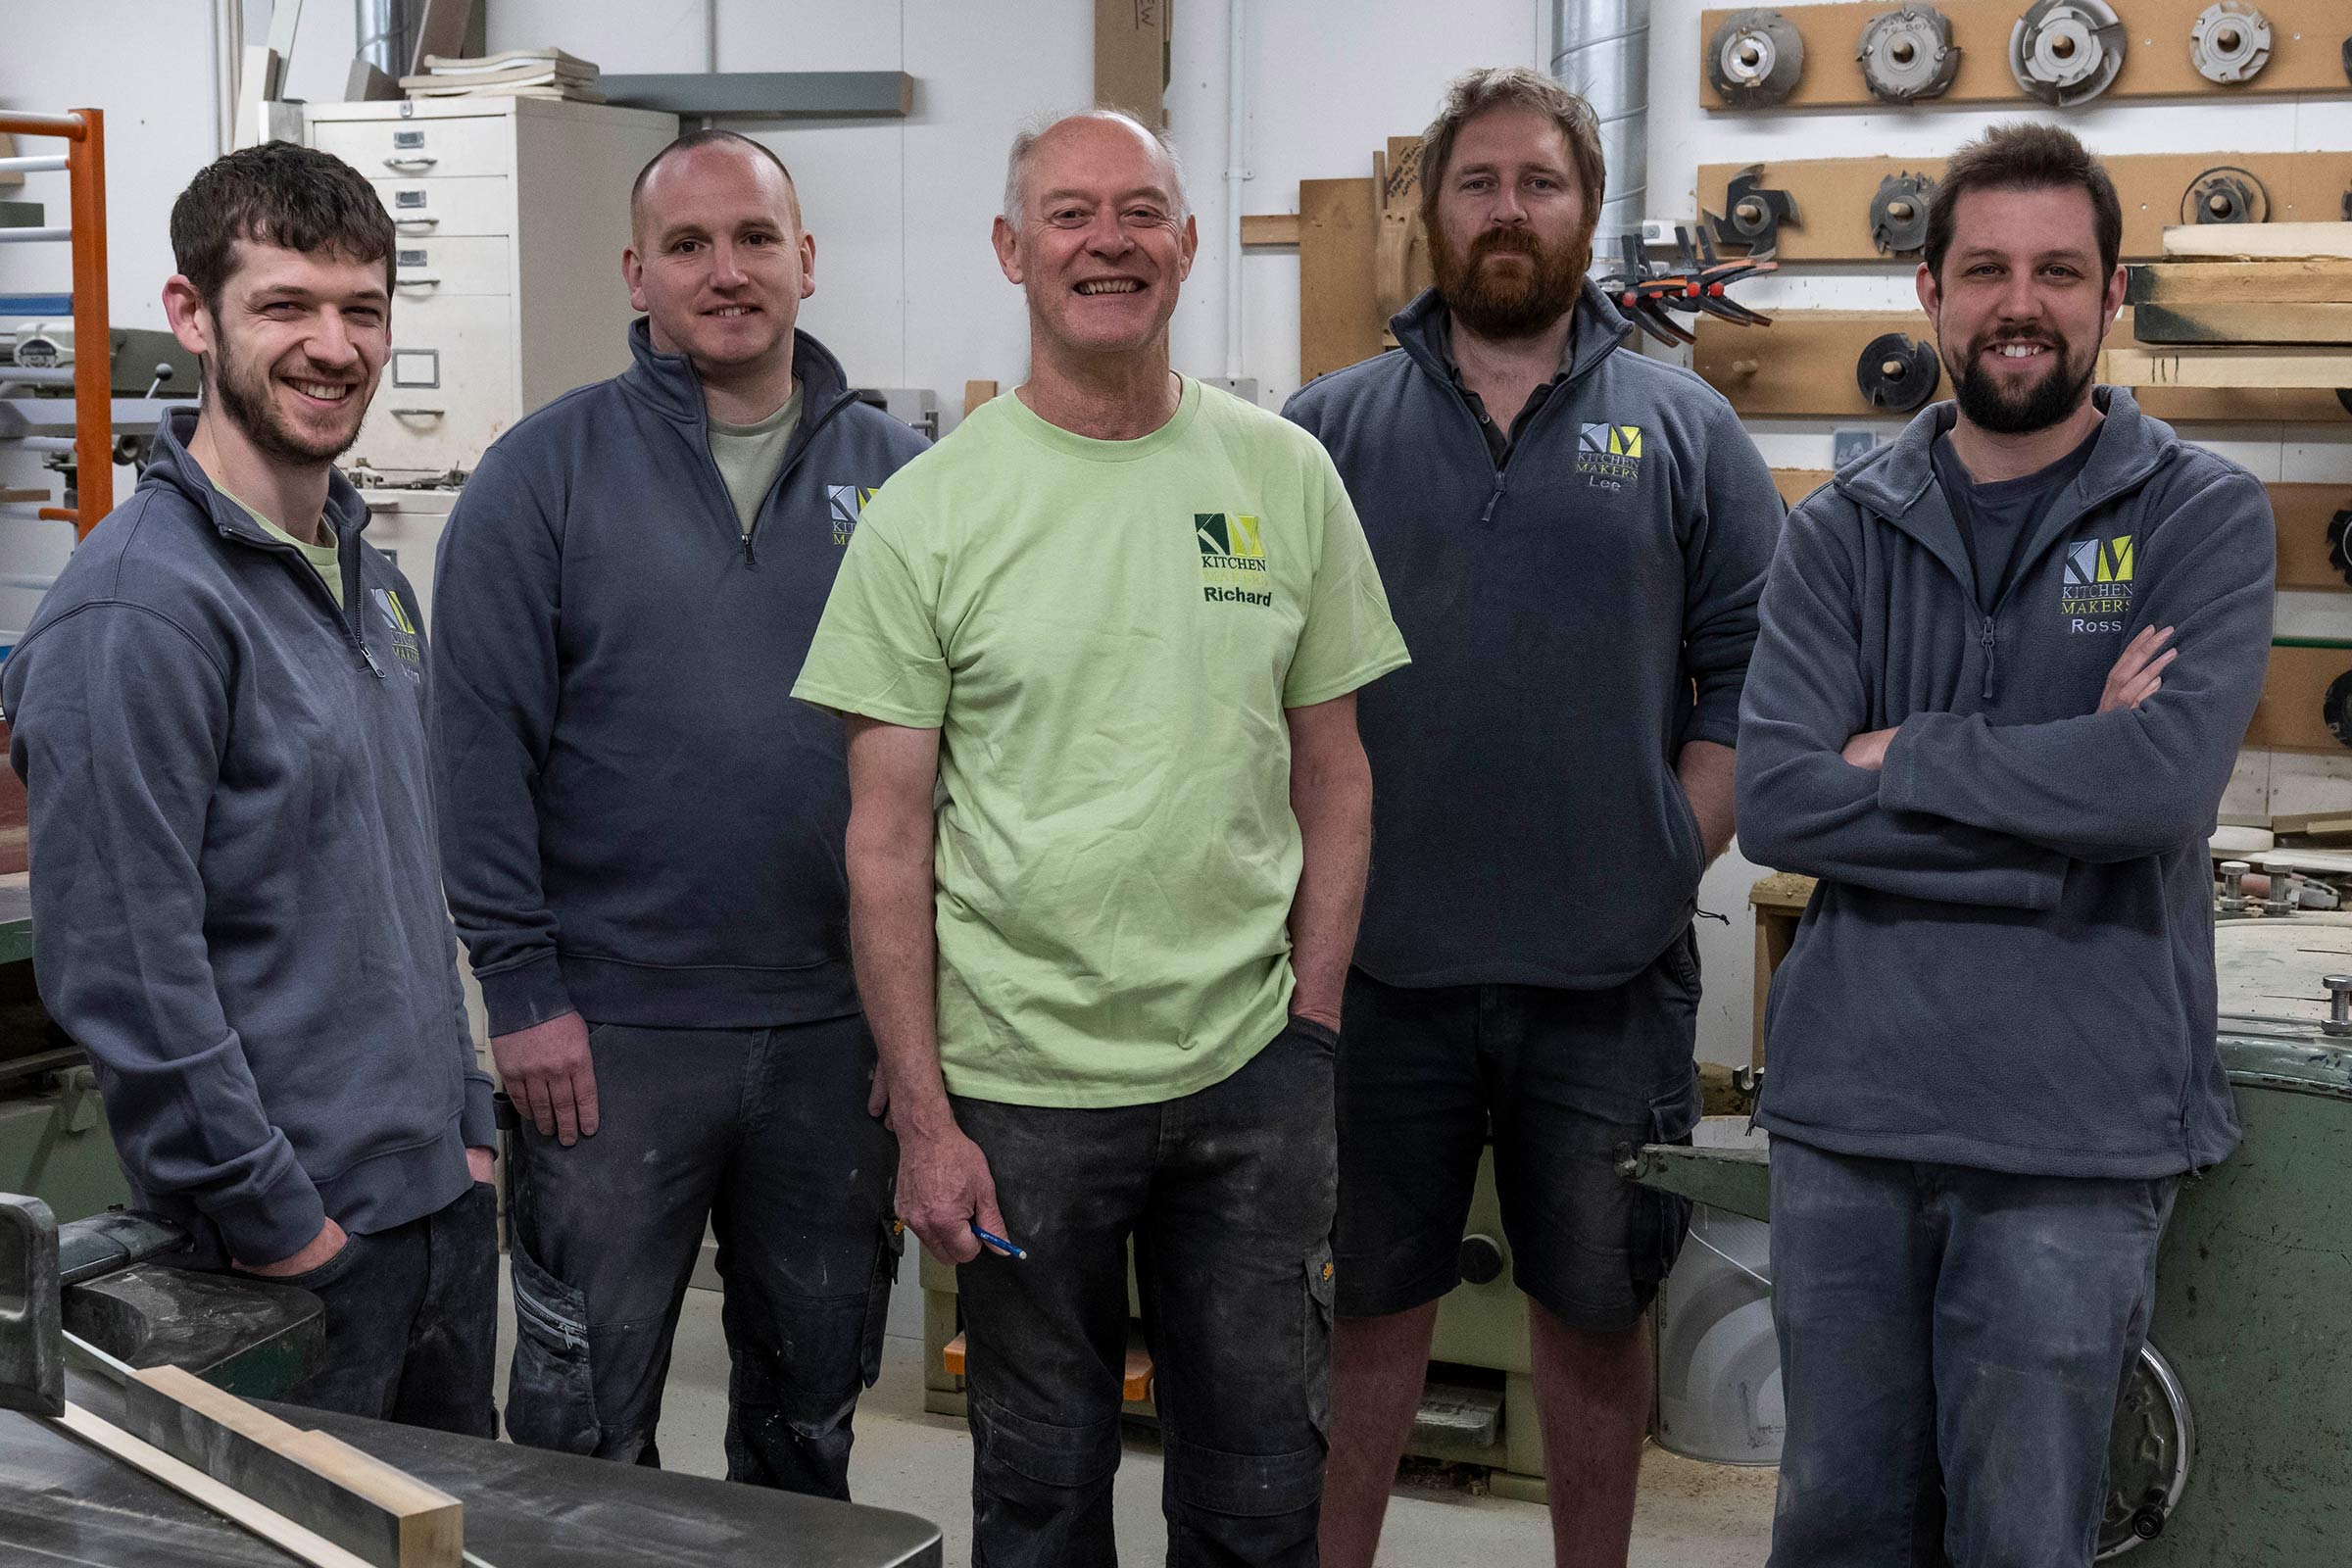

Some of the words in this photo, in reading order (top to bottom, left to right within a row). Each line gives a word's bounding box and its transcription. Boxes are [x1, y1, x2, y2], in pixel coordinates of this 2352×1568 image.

[1577, 452, 1640, 468] KITCHEN
[1576, 463, 1639, 480] MAKERS
[1589, 475, 1621, 491] Lee
[1201, 556, 1266, 571] KITCHEN
[1203, 586, 1272, 608] Richard
[2062, 583, 2132, 599] KITCHEN
[2071, 618, 2122, 634] Ross
